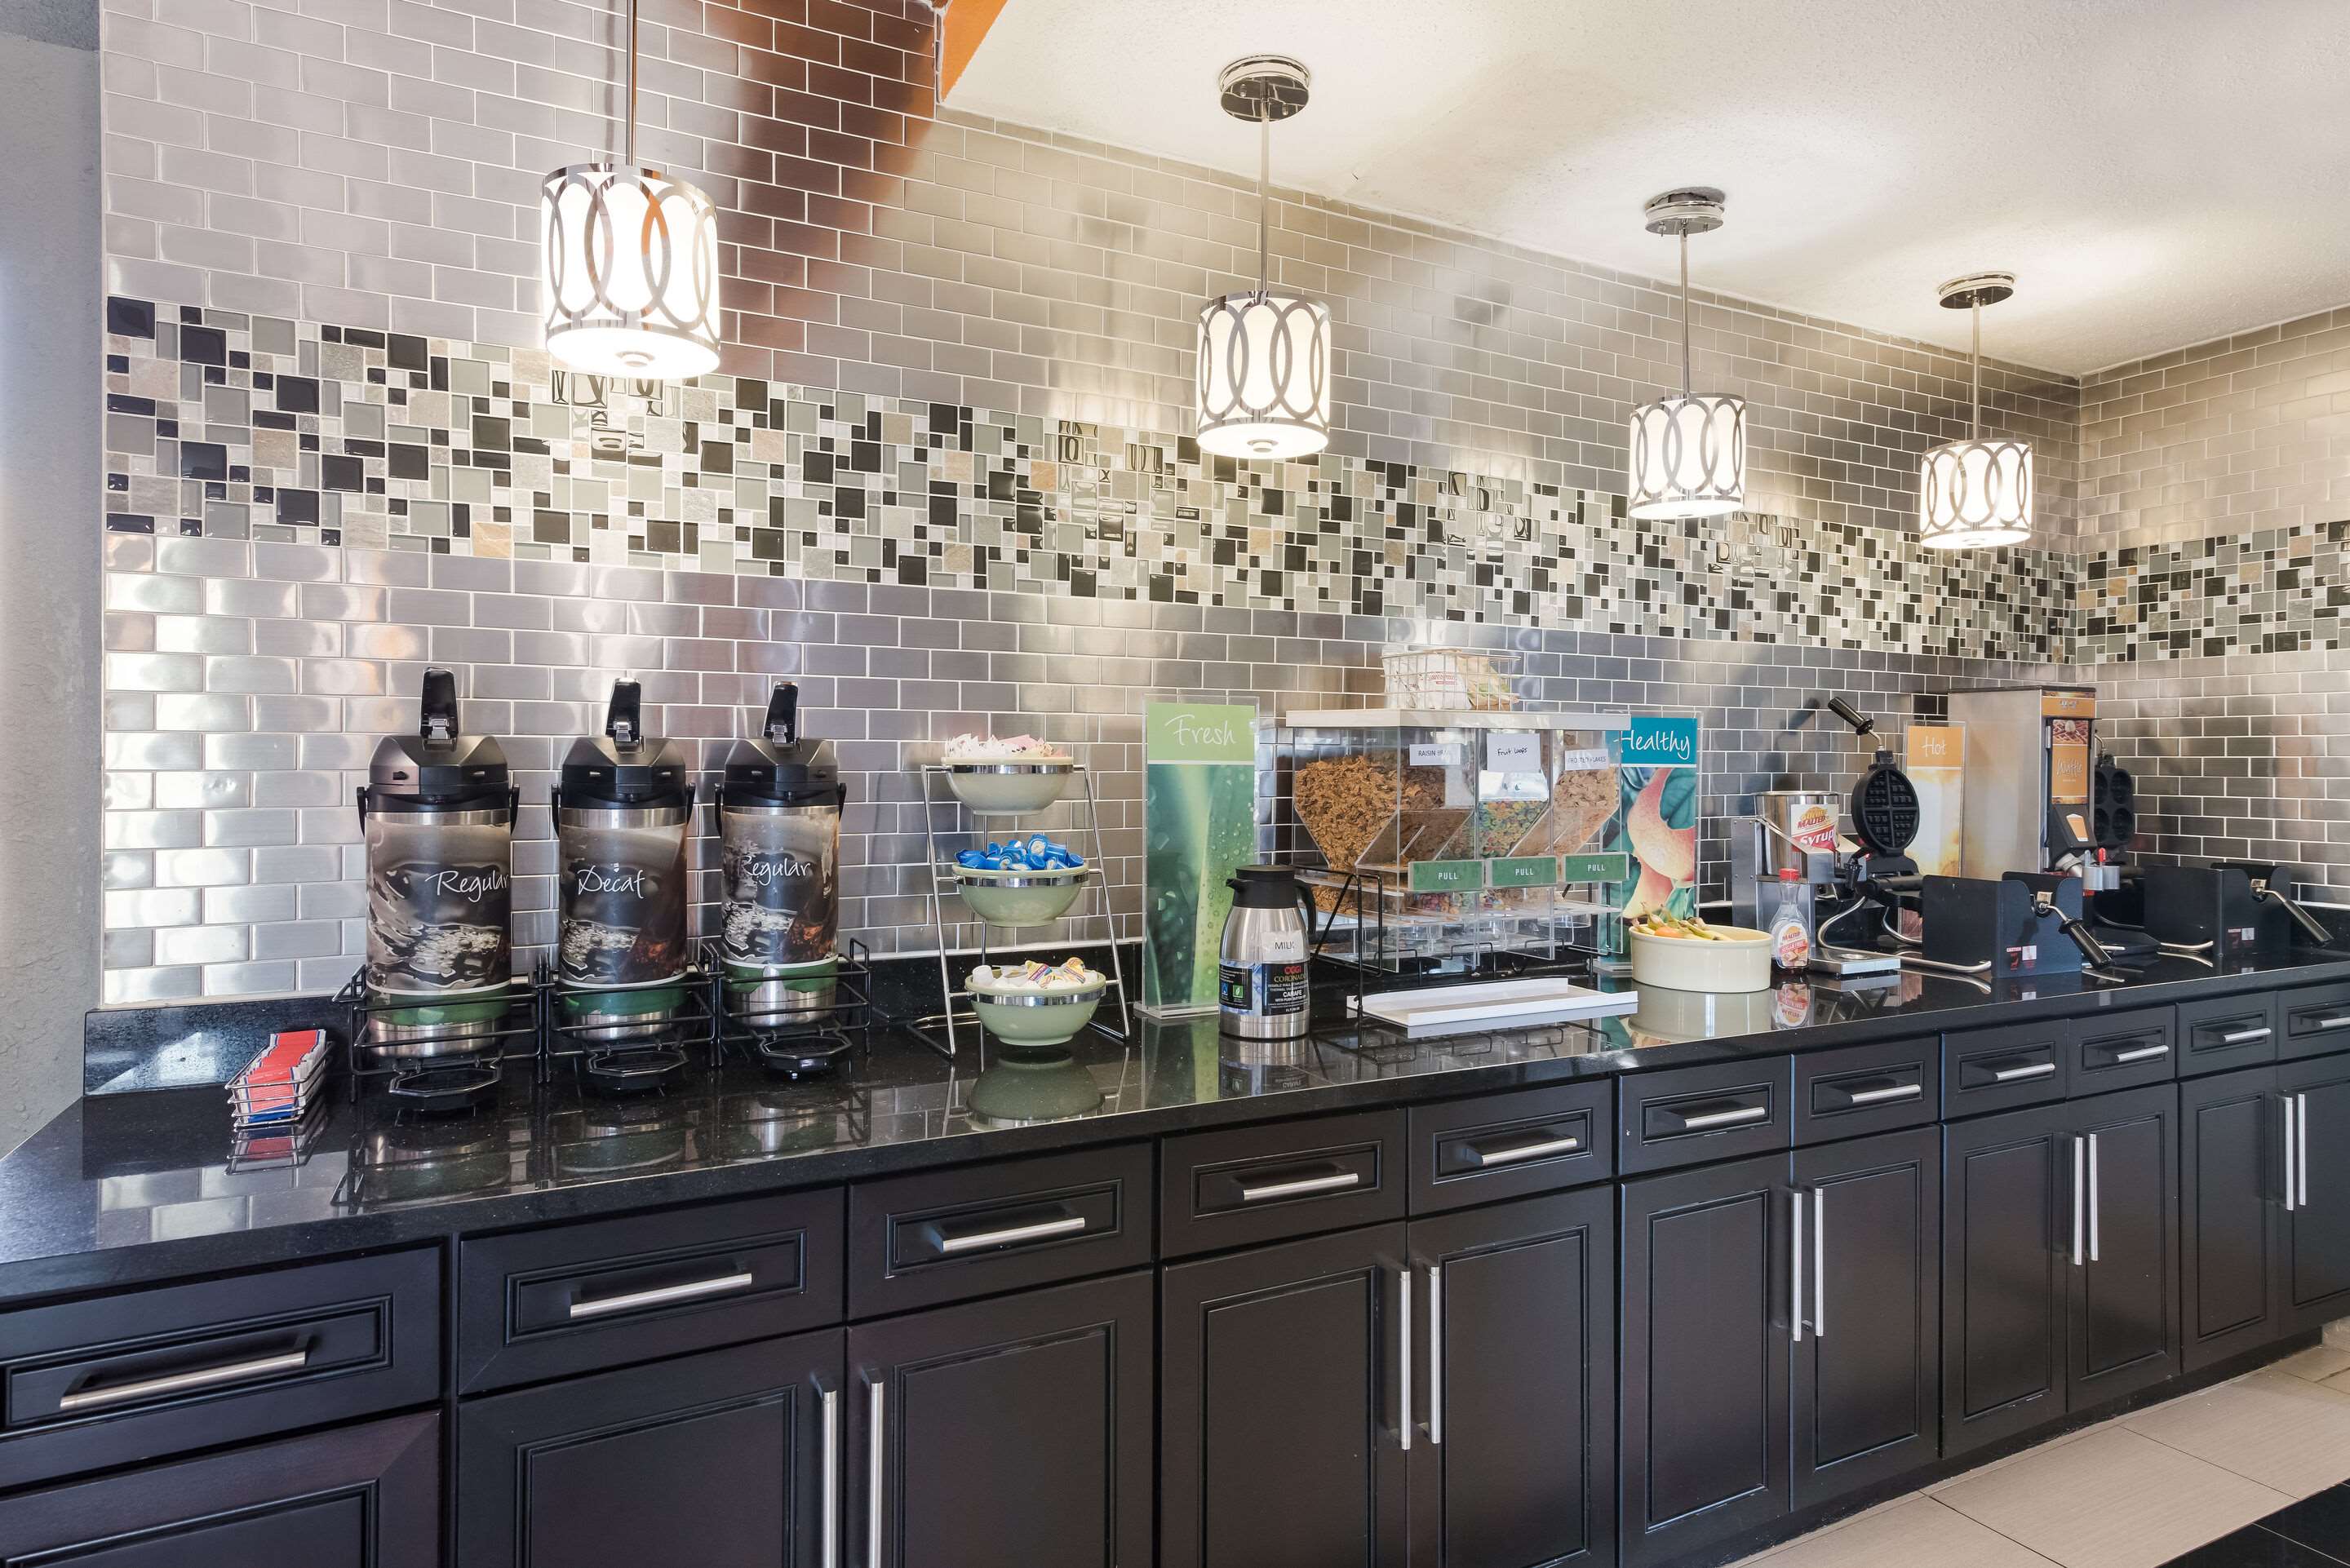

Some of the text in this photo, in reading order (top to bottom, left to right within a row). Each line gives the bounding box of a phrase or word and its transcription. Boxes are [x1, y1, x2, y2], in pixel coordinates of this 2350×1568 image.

[1164, 714, 1236, 746] Fresh
[1922, 736, 1947, 756] Hot
[1800, 829, 1834, 845] Syrup
[577, 865, 645, 899] Decaf
[738, 857, 811, 886] Regular
[1438, 872, 1458, 880] PULL
[1515, 868, 1534, 876] PULL
[425, 870, 509, 902] Regular
